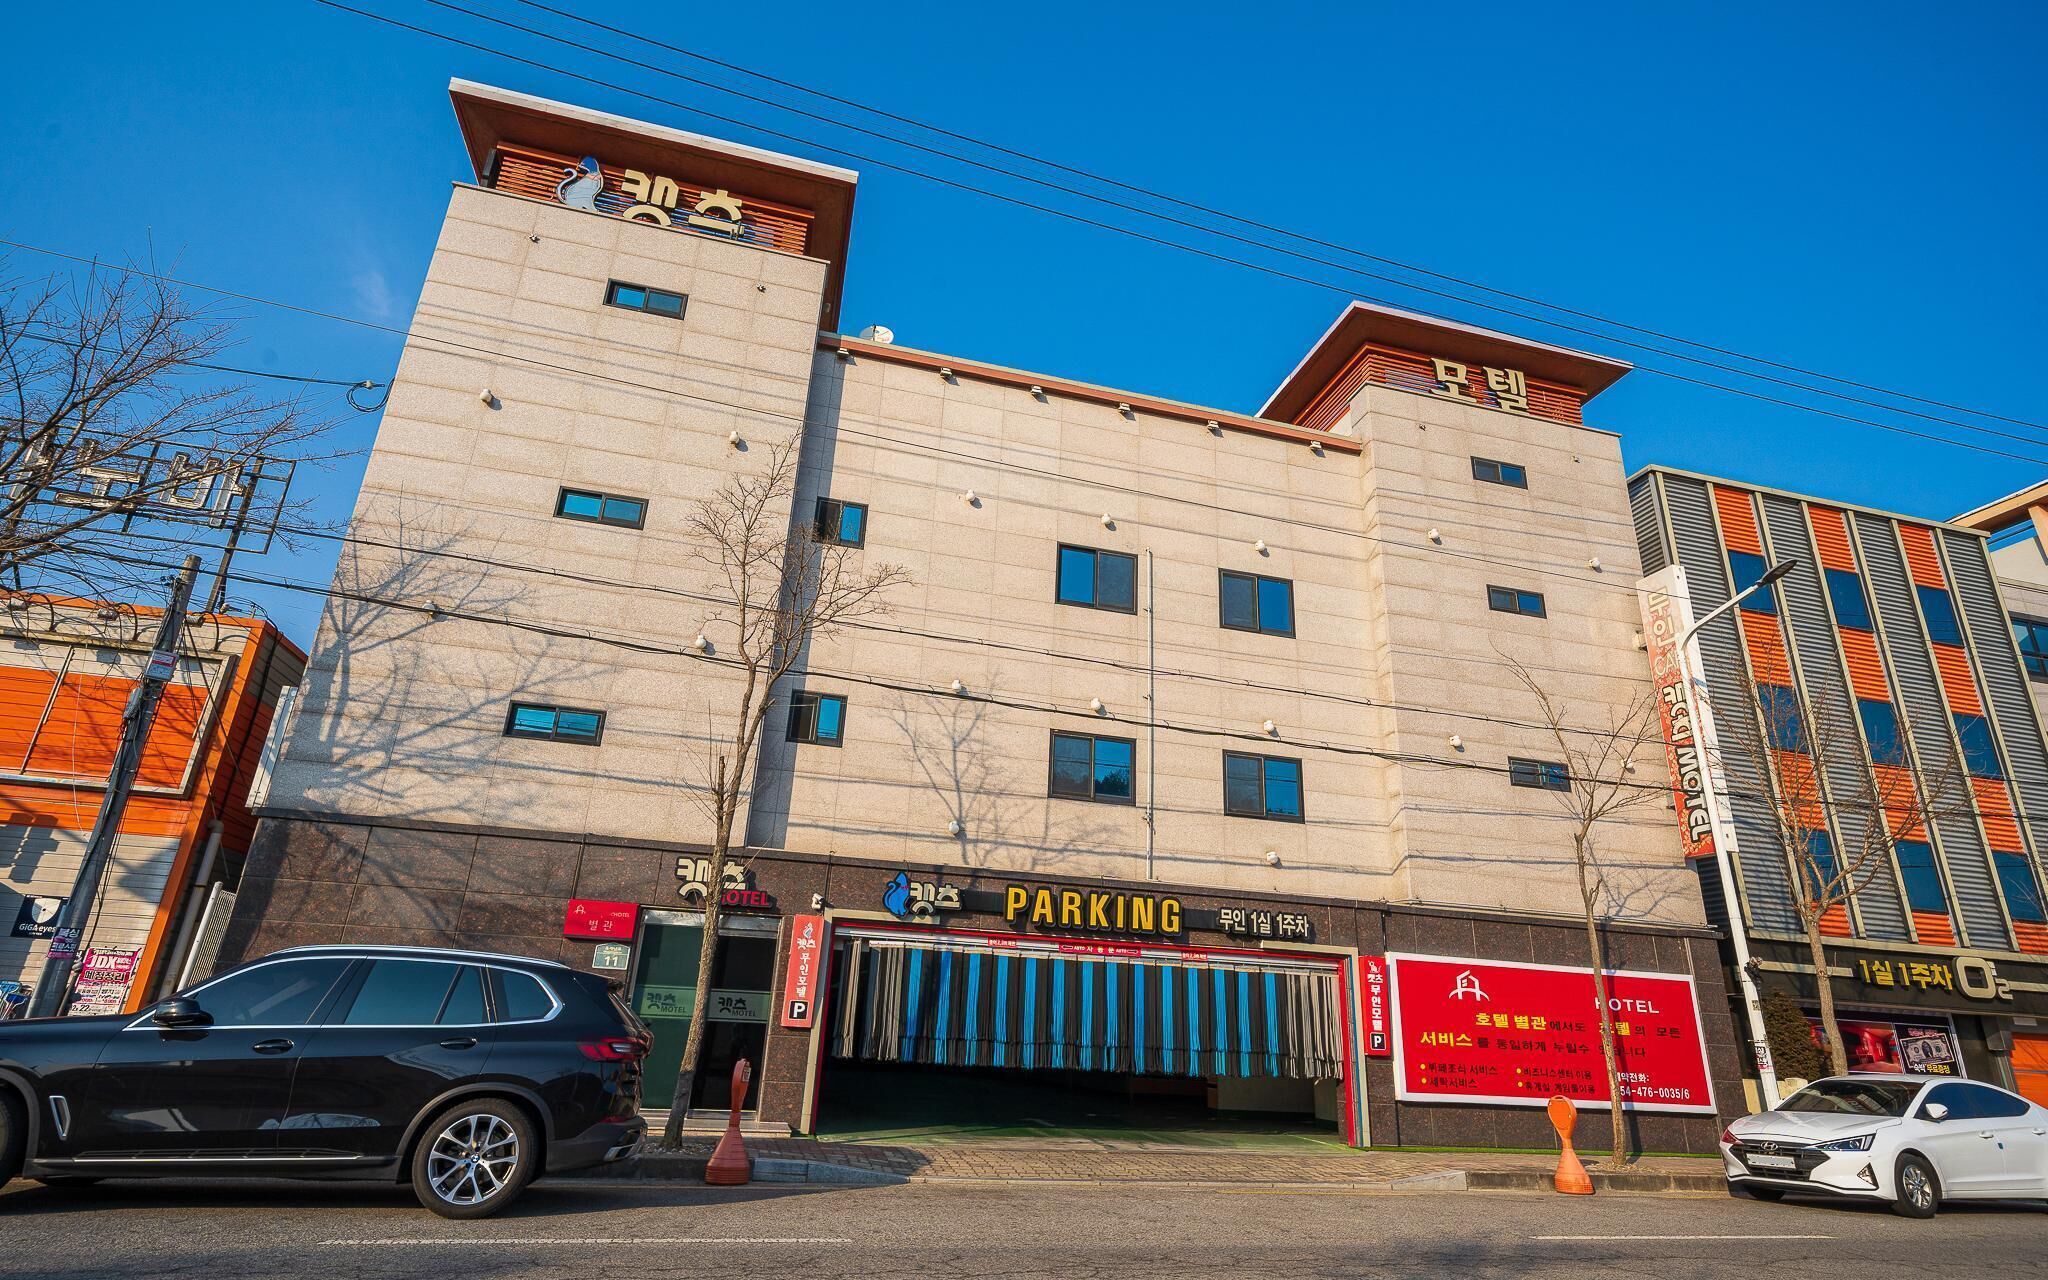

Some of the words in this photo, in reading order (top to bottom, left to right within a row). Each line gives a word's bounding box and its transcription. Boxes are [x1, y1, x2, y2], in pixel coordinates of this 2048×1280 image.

[1428, 357, 1531, 413] 모텔
[1677, 747, 1712, 842] MOTEL
[721, 889, 769, 907] OTEL
[1006, 887, 1180, 933] PARKING
[1219, 908, 1246, 931] 무인
[1250, 911, 1271, 934] 1실
[1276, 913, 1309, 937] 1주차
[86, 955, 118, 970] JDX
[604, 956, 619, 967] 11
[796, 952, 811, 998] 무인모텔
[1859, 959, 1894, 986] 1실
[1898, 962, 1953, 990] 1주차
[660, 1005, 687, 1014] MOTEL
[731, 1009, 757, 1017] MOTEL
[793, 1002, 806, 1018] P
[1370, 984, 1382, 1031] 무인모텔
[1475, 1012, 1509, 1028] 호텔
[1514, 1014, 1547, 1030] 별관
[1598, 1021, 1631, 1036] 텔
[1656, 1026, 1681, 1038] 모든
[1373, 1035, 1382, 1048] P
[1420, 1031, 1473, 1047] 서비스
[1470, 1064, 1498, 1075] 서비스
[1620, 1085, 1690, 1099] 54-476-0035/6
